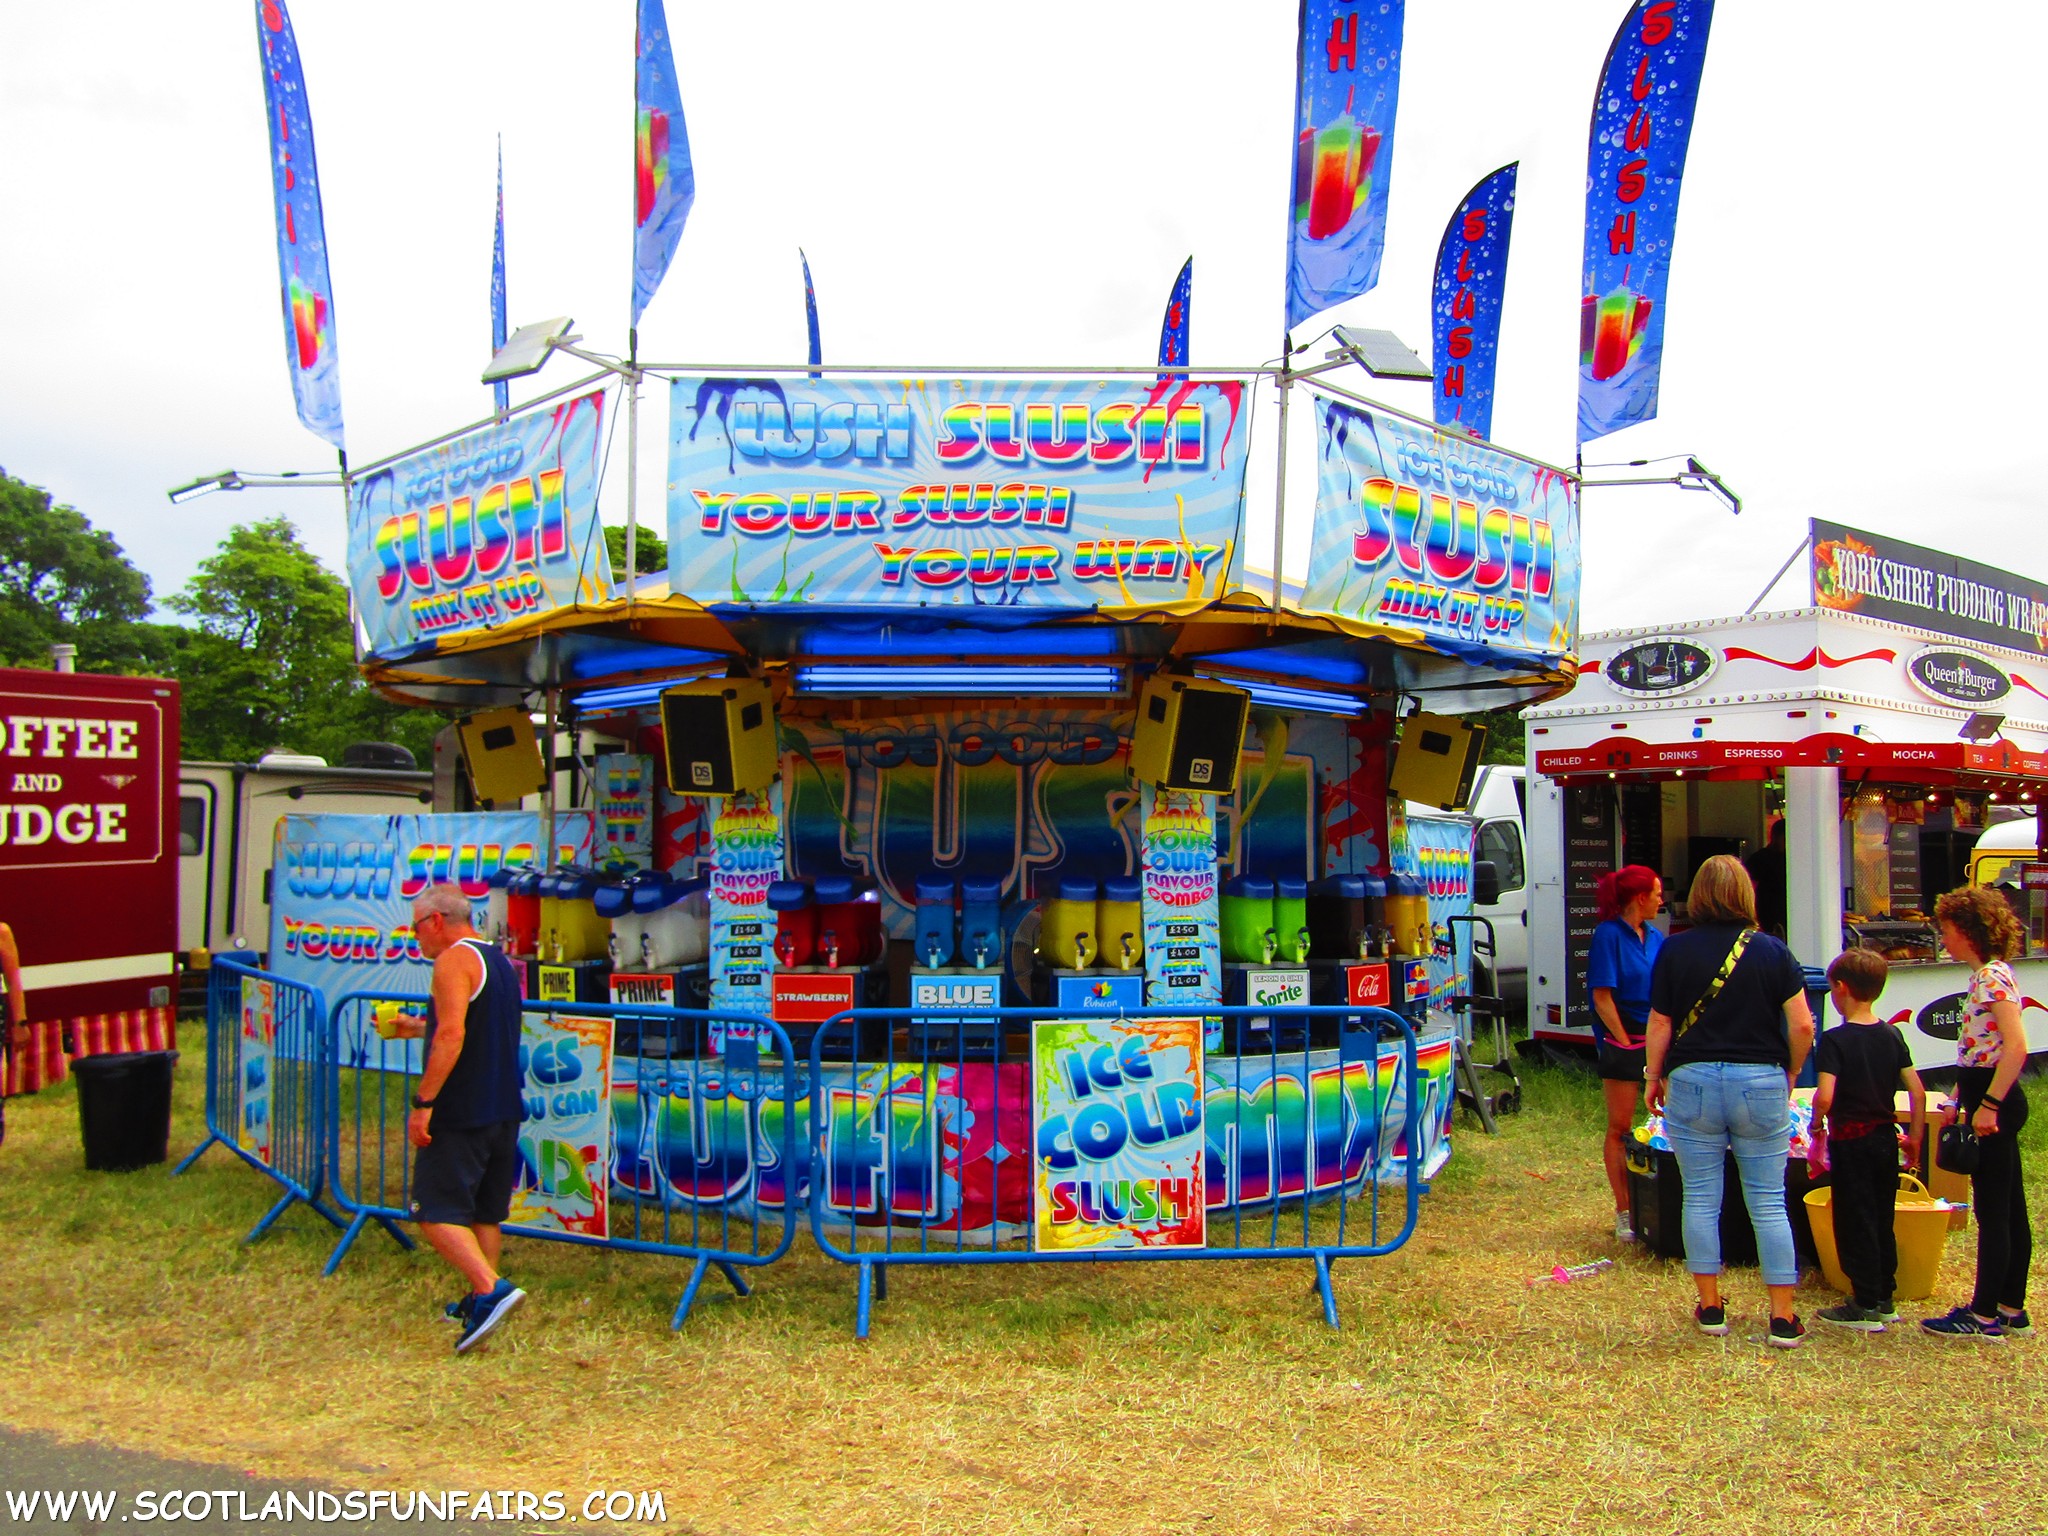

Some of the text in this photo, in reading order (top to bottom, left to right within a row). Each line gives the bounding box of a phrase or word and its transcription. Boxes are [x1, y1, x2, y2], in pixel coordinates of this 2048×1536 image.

[1609, 0, 1675, 256] SLUSH
[1444, 208, 1487, 398] SLUSH
[933, 401, 1205, 464] SLUSH
[1396, 437, 1517, 500] ICE COLD
[690, 483, 1073, 533] YOUR SLUSH
[375, 464, 567, 600] SLUSH
[1352, 476, 1556, 600] SLUSH
[871, 538, 1222, 586] YOUR WAY
[409, 570, 541, 630] MIX IT UP
[1379, 576, 1524, 633] MIX IT UP
[1833, 547, 2048, 639] YORKSHIRE PUDDING WRAP
[1925, 660, 1997, 697] Queen Burger
[0, 715, 138, 759] FFEE
[1193, 763, 1210, 774] DS
[1543, 756, 1582, 767] CHILLED
[1659, 750, 1698, 761] DRINKS
[1725, 748, 1783, 759] ESPRESSO
[1892, 750, 1935, 760] MOCHA
[1972, 753, 1984, 764] TEA
[11, 773, 63, 793] AND
[694, 766, 710, 777] DS
[0, 803, 128, 846] DGE
[715, 829, 779, 850] YOUR
[1148, 829, 1214, 853] YOUR
[1150, 852, 1210, 872] OWN
[1146, 872, 1214, 891] FLAVOUR
[1575, 881, 1592, 889] BACON
[714, 886, 768, 906] COMB
[1147, 886, 1214, 907] COMBO
[1569, 906, 1591, 915] CHICKEN
[282, 915, 381, 961] YOUR
[542, 971, 572, 994] PRIME
[616, 978, 667, 1003] PRIME
[1254, 975, 1279, 983] LEMON
[1357, 974, 1380, 999] Cola
[775, 993, 850, 1003] STRAWBERRY
[917, 985, 994, 1005] BLUE
[1255, 983, 1303, 1006] Sprite
[1066, 1036, 1153, 1101] ICE
[552, 1089, 598, 1118] CAN
[1038, 1081, 1202, 1171] COLD
[1051, 1178, 1191, 1224] SLUSH
